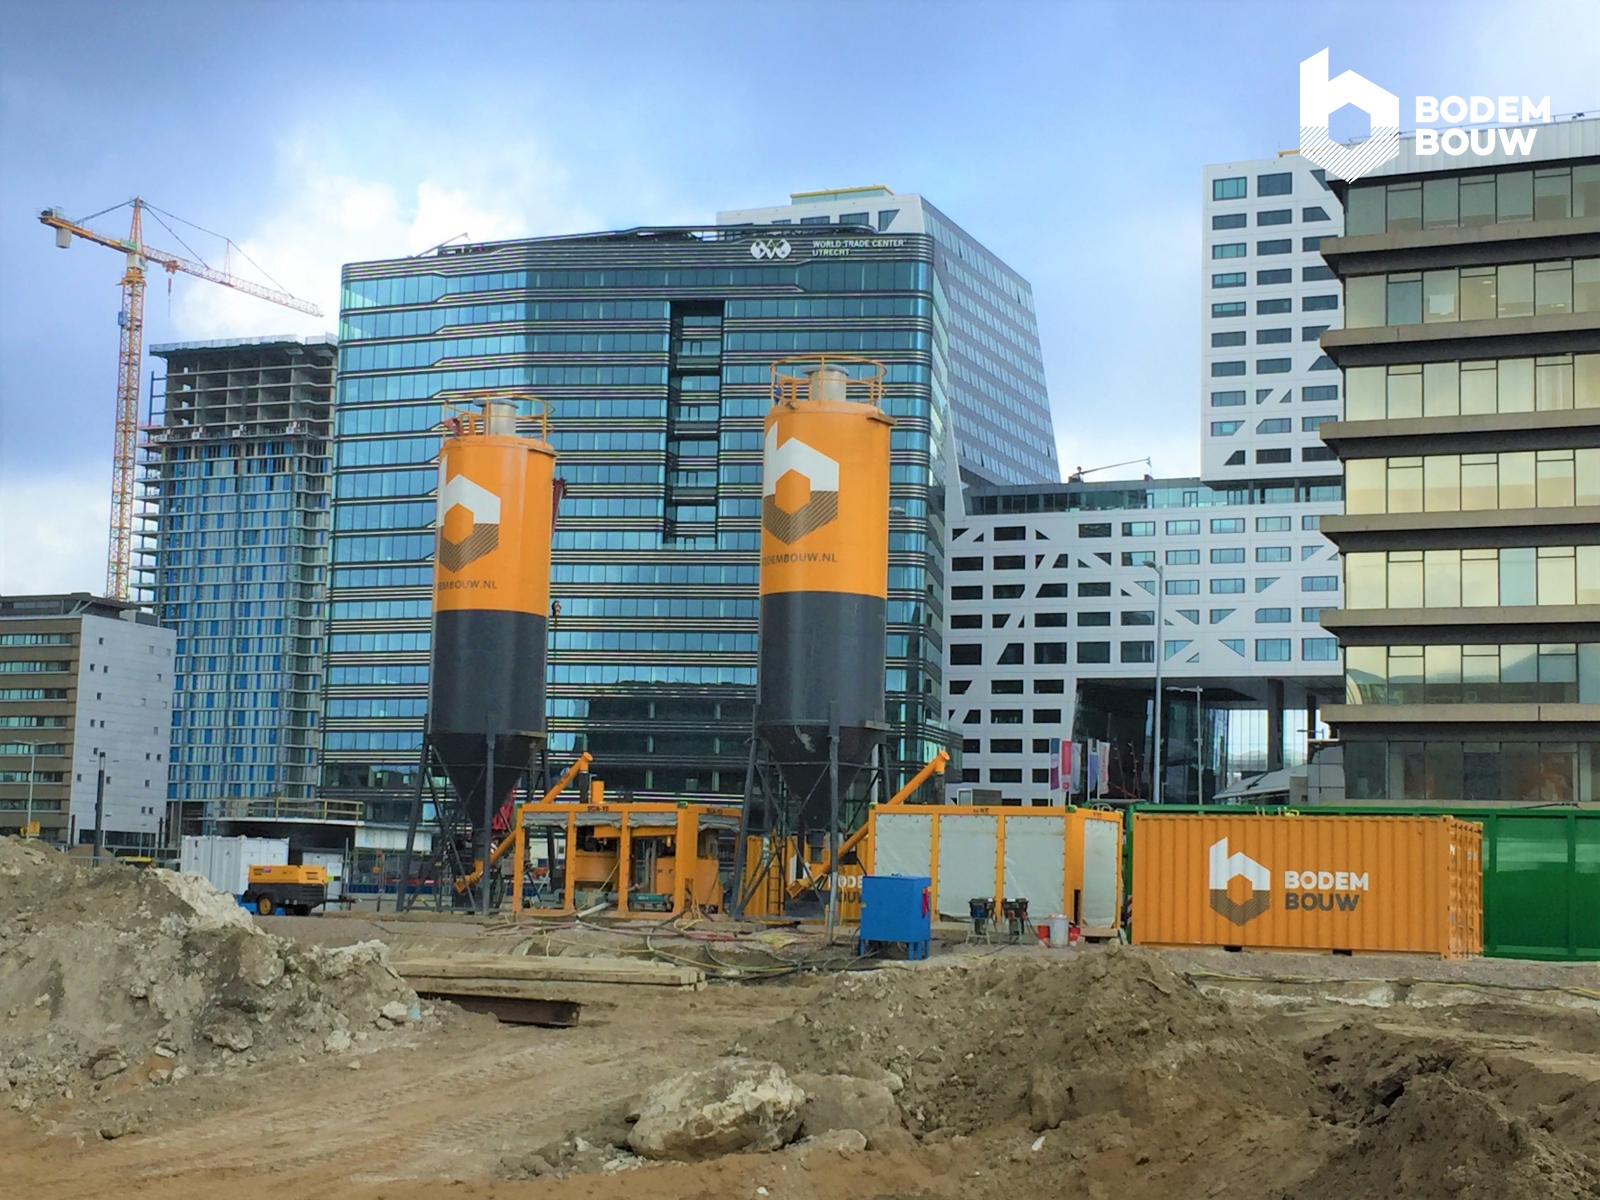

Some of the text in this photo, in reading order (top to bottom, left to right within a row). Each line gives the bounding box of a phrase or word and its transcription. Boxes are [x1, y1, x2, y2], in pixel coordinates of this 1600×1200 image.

[812, 239, 905, 248] WORLD TRADE CENTER
[812, 249, 850, 257] UTRECHT
[1284, 870, 1369, 891] BODEM
[1285, 892, 1360, 912] BOUW
